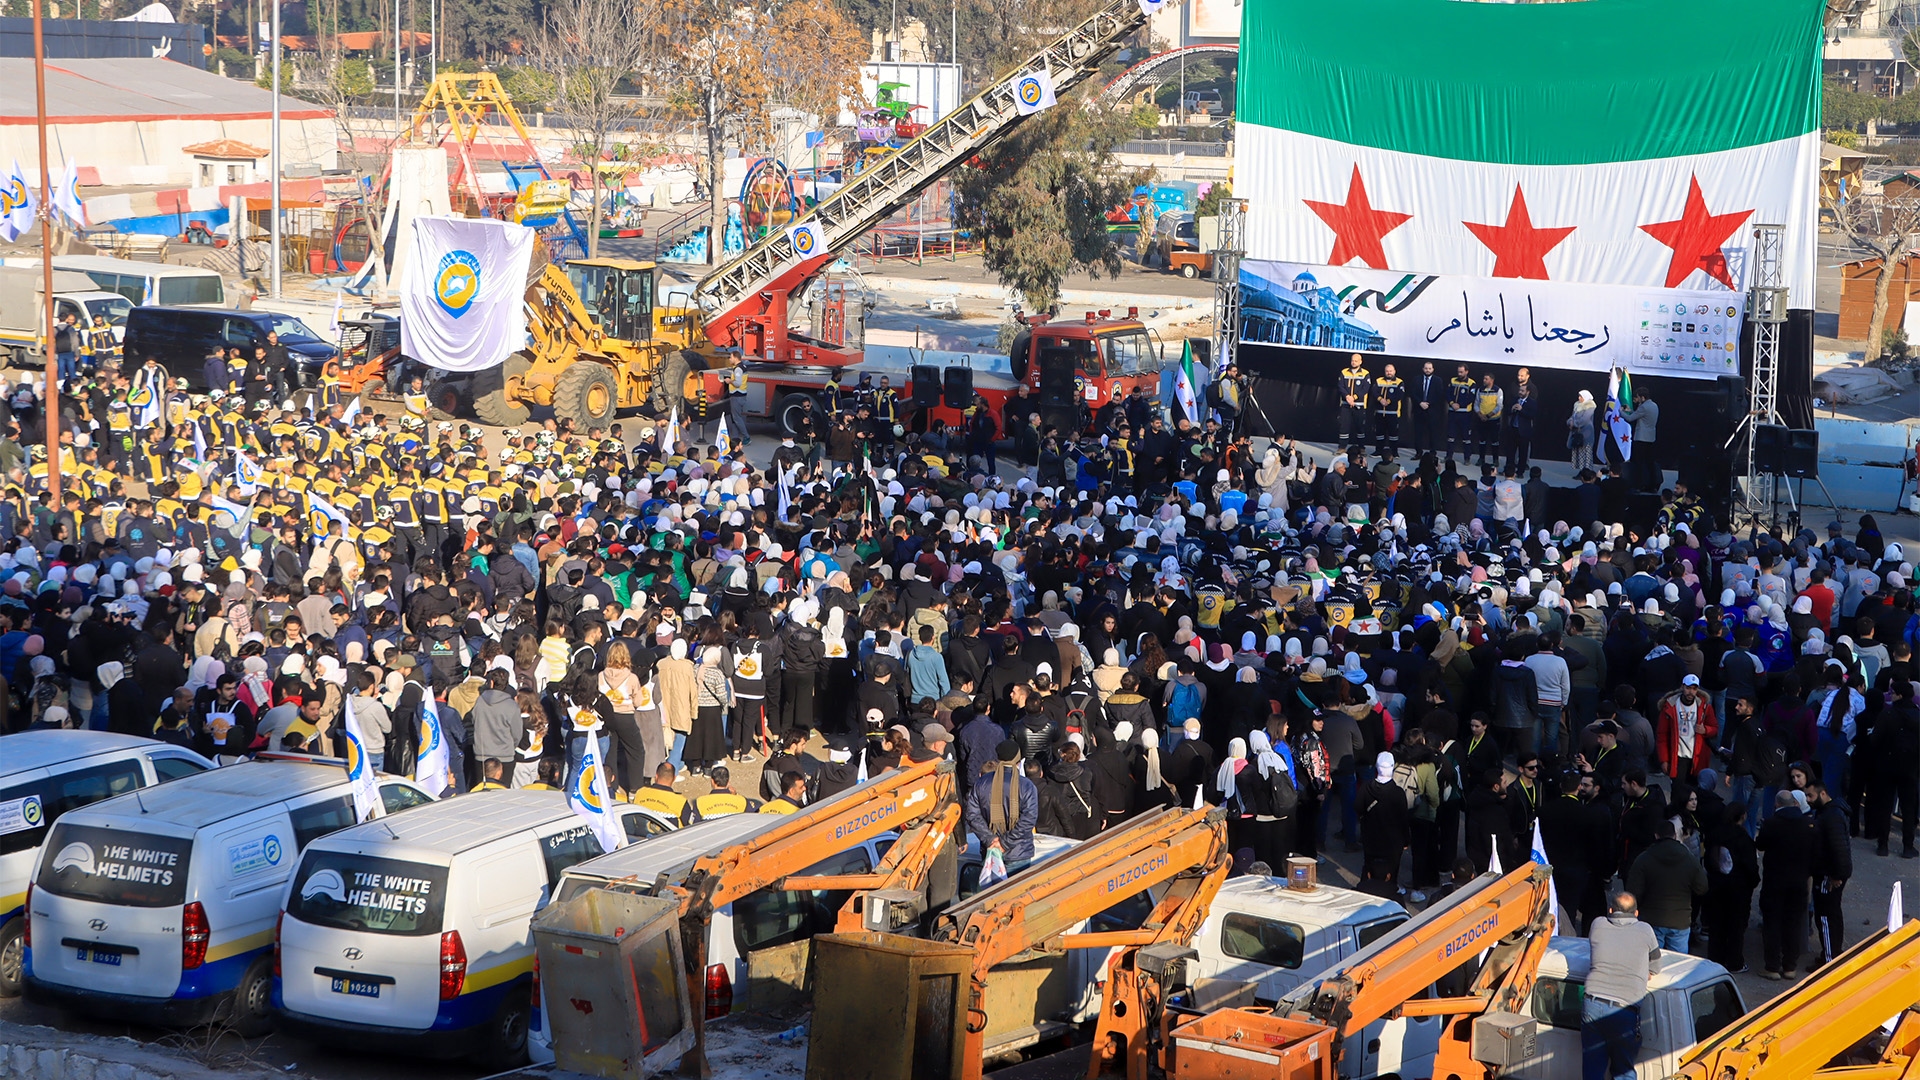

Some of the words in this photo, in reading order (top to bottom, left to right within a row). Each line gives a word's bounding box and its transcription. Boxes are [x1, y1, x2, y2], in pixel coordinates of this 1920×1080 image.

[1527, 294, 1610, 355] رجعنا
[835, 801, 897, 839] BIZZOCCHI
[103, 844, 130, 860] THE
[131, 849, 179, 866] WHITE
[96, 861, 174, 887] HELMETS
[354, 872, 382, 888] THE
[384, 875, 432, 894] WHITE
[1107, 853, 1168, 893] BIZZOCCHI
[347, 889, 427, 915] HELMETS
[1446, 913, 1498, 957] BIZZOCCHI
[94, 952, 121, 964] 10677
[350, 982, 378, 994] 10289
